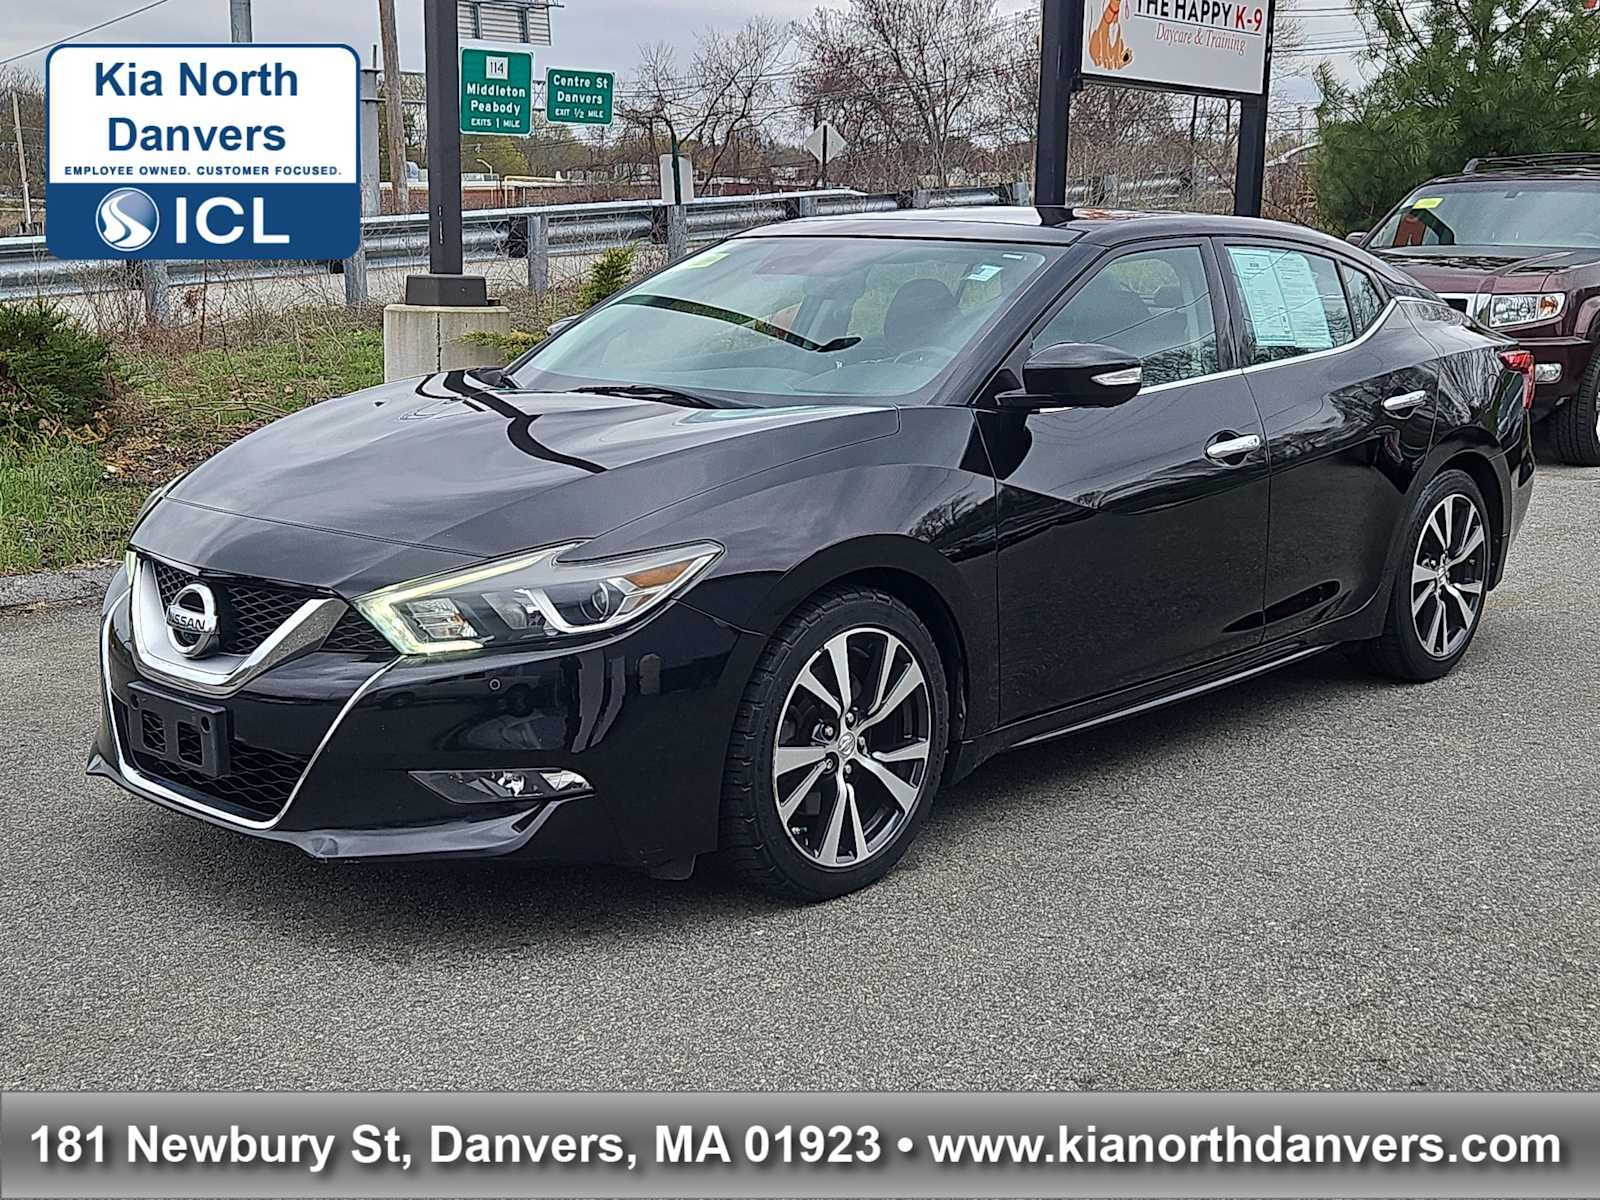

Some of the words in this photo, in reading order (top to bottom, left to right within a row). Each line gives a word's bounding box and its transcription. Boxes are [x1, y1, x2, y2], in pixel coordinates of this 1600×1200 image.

[1136, 0, 1169, 17] THE
[1175, 0, 1232, 27] HAPPY
[1235, 5, 1263, 32] K-9
[1156, 23, 1192, 46] Daycare
[1194, 28, 1203, 45] &
[1205, 30, 1247, 57] Training
[490, 61, 504, 74] 114
[553, 74, 591, 88] Centre
[596, 77, 609, 89] St
[467, 83, 526, 98] Middleton
[557, 91, 603, 105] Danvers
[471, 100, 521, 116] Peabody
[555, 108, 570, 116] EXIT
[588, 110, 604, 119] MILE
[471, 118, 492, 127] EXITS
[496, 117, 500, 129] 1
[503, 120, 521, 128] MILE
